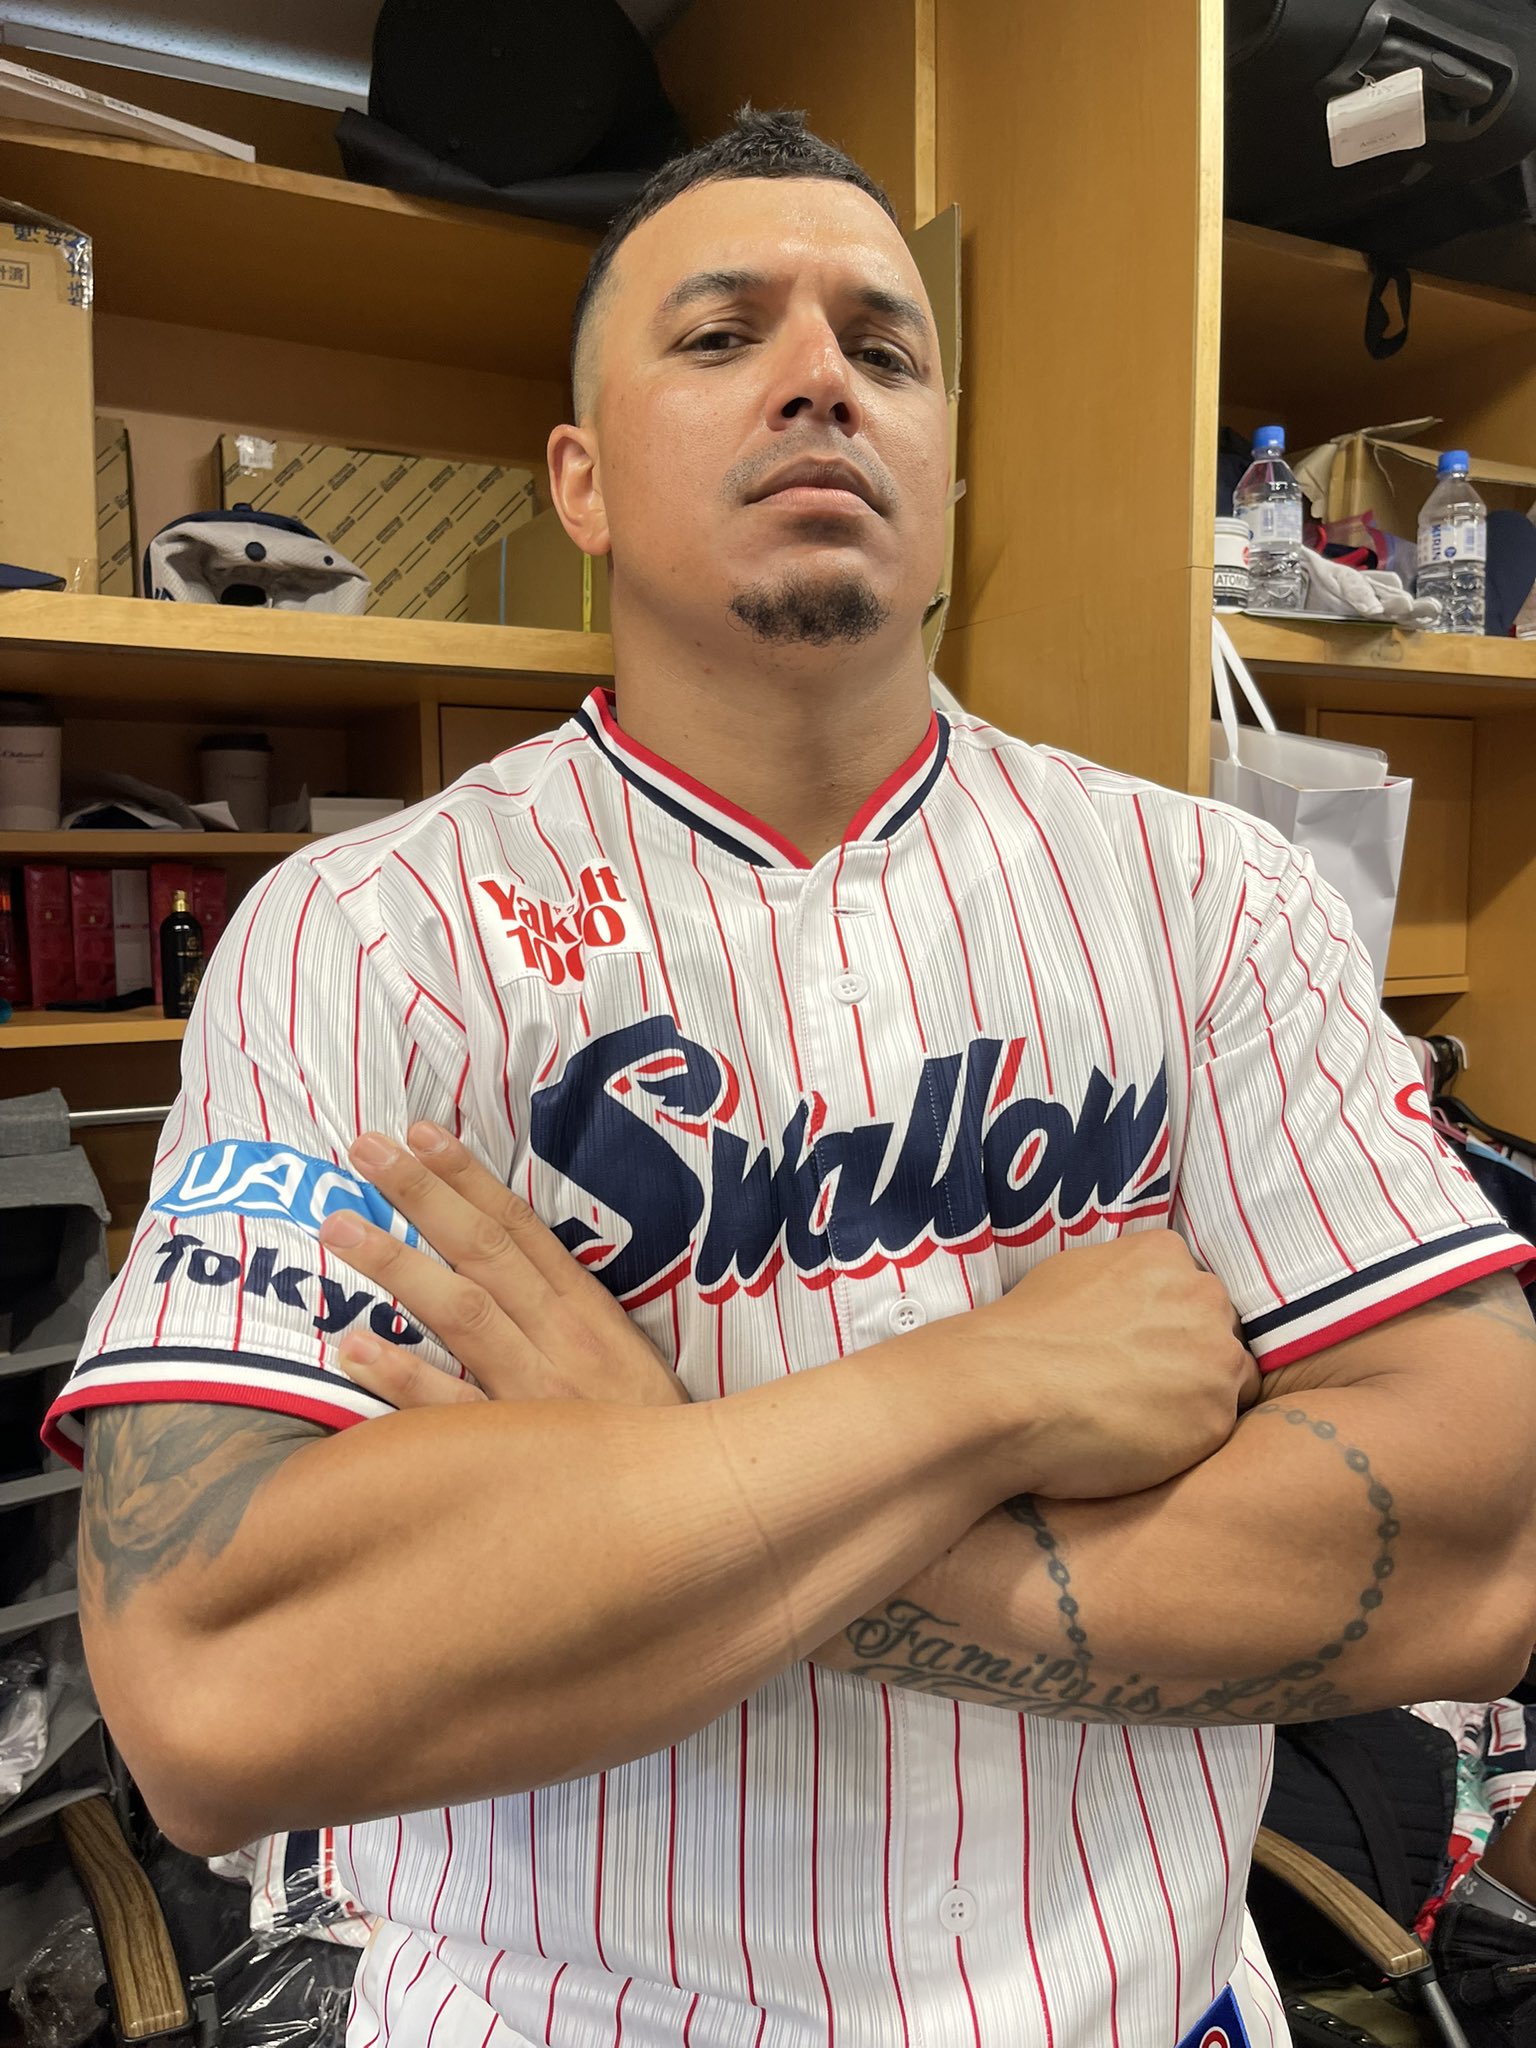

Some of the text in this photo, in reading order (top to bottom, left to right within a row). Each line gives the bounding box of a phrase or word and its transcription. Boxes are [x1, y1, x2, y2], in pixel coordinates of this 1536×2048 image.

[161, 1144, 409, 1246] UAC
[531, 1014, 1172, 1302] Swallow
[154, 1234, 424, 1346] Tokyo
[846, 1600, 1096, 1701] Family
